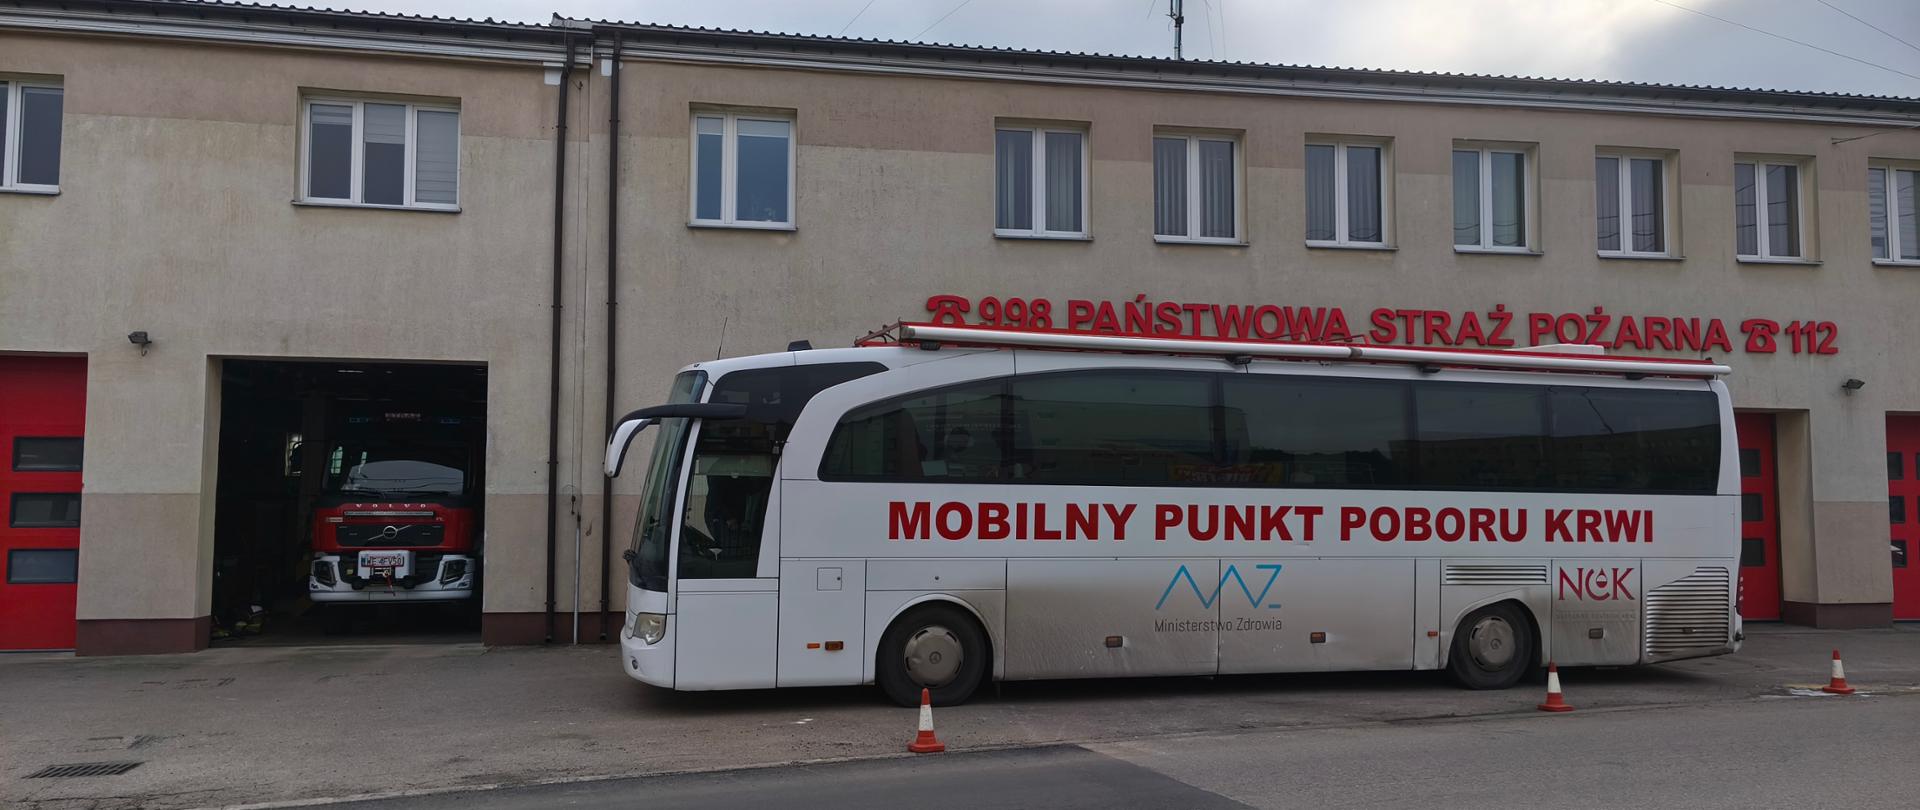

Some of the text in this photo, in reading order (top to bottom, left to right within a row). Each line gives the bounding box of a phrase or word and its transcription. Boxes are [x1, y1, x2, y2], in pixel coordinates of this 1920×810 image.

[979, 293, 1839, 354] 998 PAŃSTWOWA STRAŻ POŻARNA 112
[888, 501, 1654, 543] MOBILNY PUNKT POBORU KRWI
[1154, 617, 1282, 633] Ministerstwo Zdrowia
